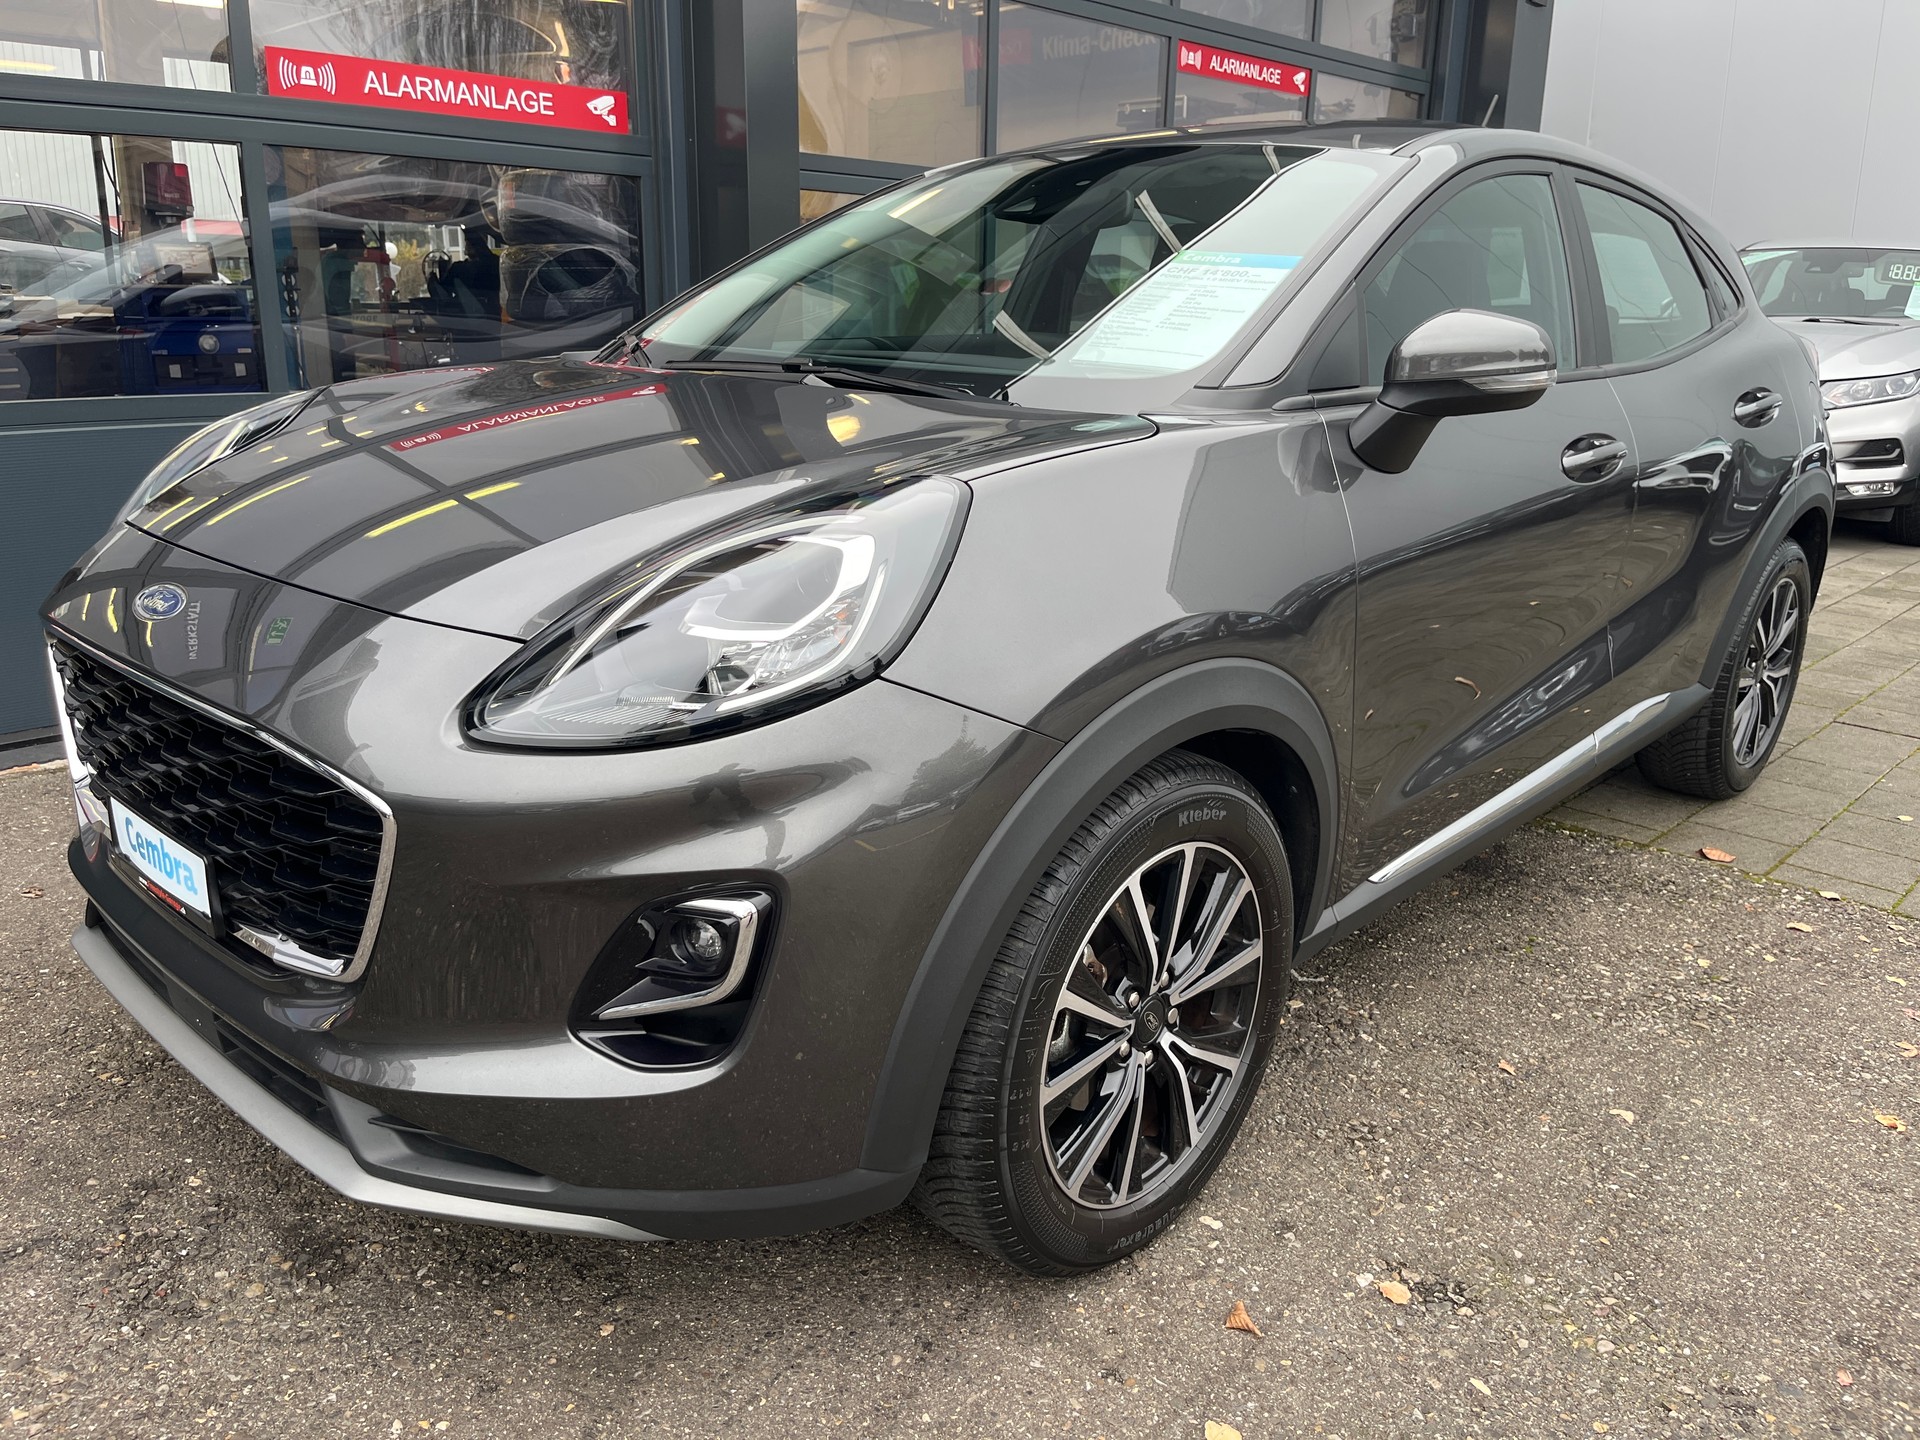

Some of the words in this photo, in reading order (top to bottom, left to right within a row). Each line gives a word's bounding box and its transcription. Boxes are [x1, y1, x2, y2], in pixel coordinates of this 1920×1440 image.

[1209, 54, 1281, 85] ALARMANLAGE
[363, 70, 555, 116] ALARMANLAGE
[1166, 266, 1199, 275] CHF
[1182, 253, 1242, 264] Cembra
[1178, 807, 1227, 828] Kleber
[125, 816, 198, 896] Cembra
